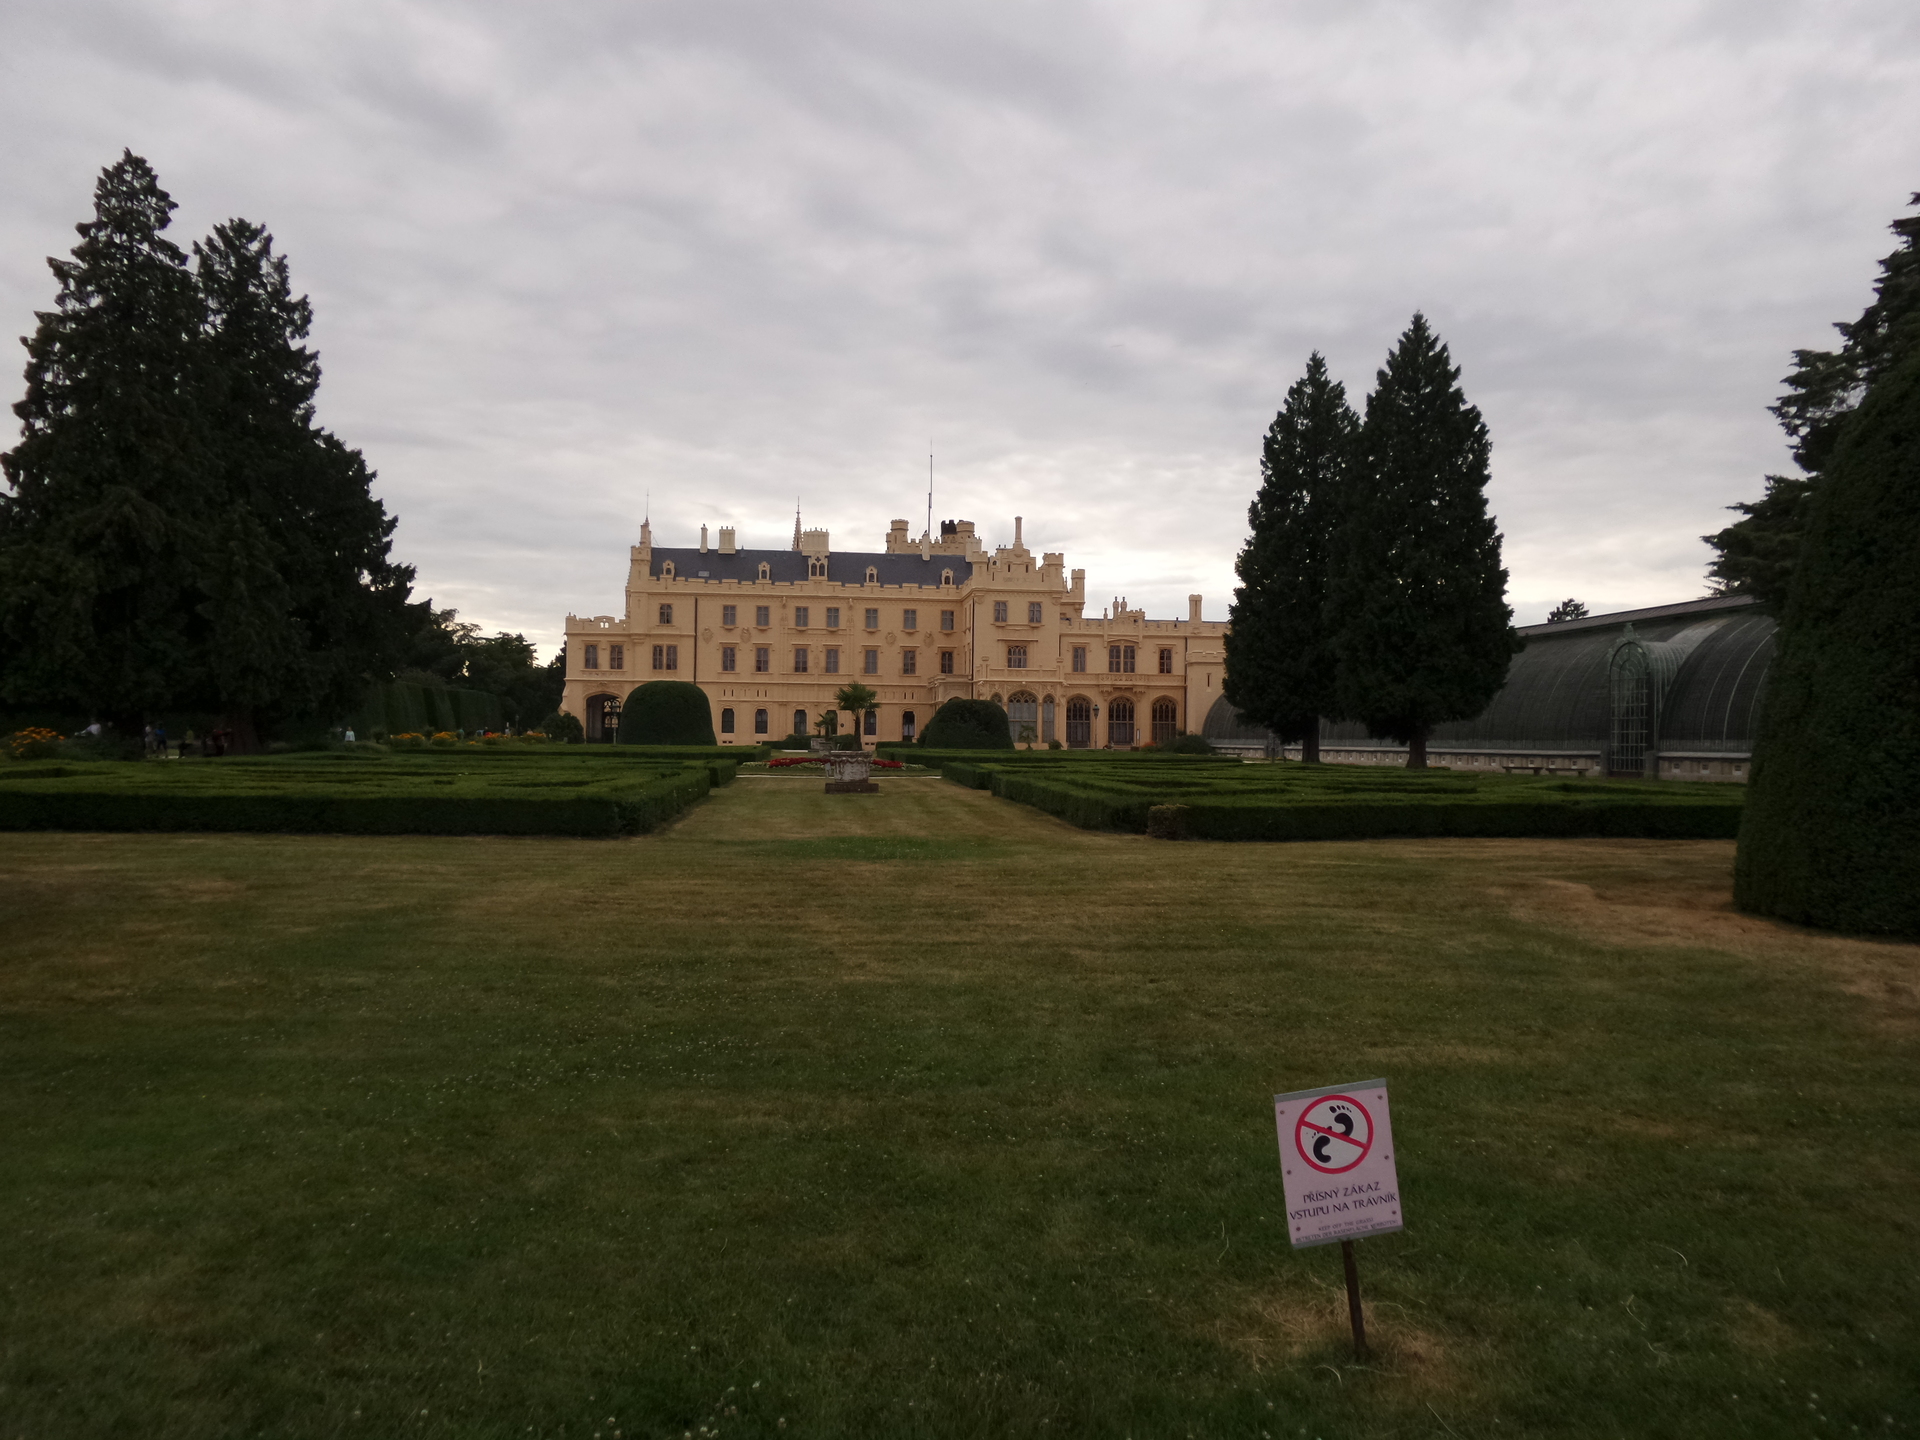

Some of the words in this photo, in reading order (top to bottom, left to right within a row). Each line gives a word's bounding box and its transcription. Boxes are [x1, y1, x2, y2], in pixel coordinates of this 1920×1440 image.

[1289, 1205, 1330, 1220] VSTUPU
[1333, 1202, 1350, 1213] NA
[1352, 1191, 1397, 1210] TRÁVNÍK
[1303, 1187, 1340, 1204] PŘÍSNÝ
[1343, 1181, 1381, 1197] ZÁKAZ
